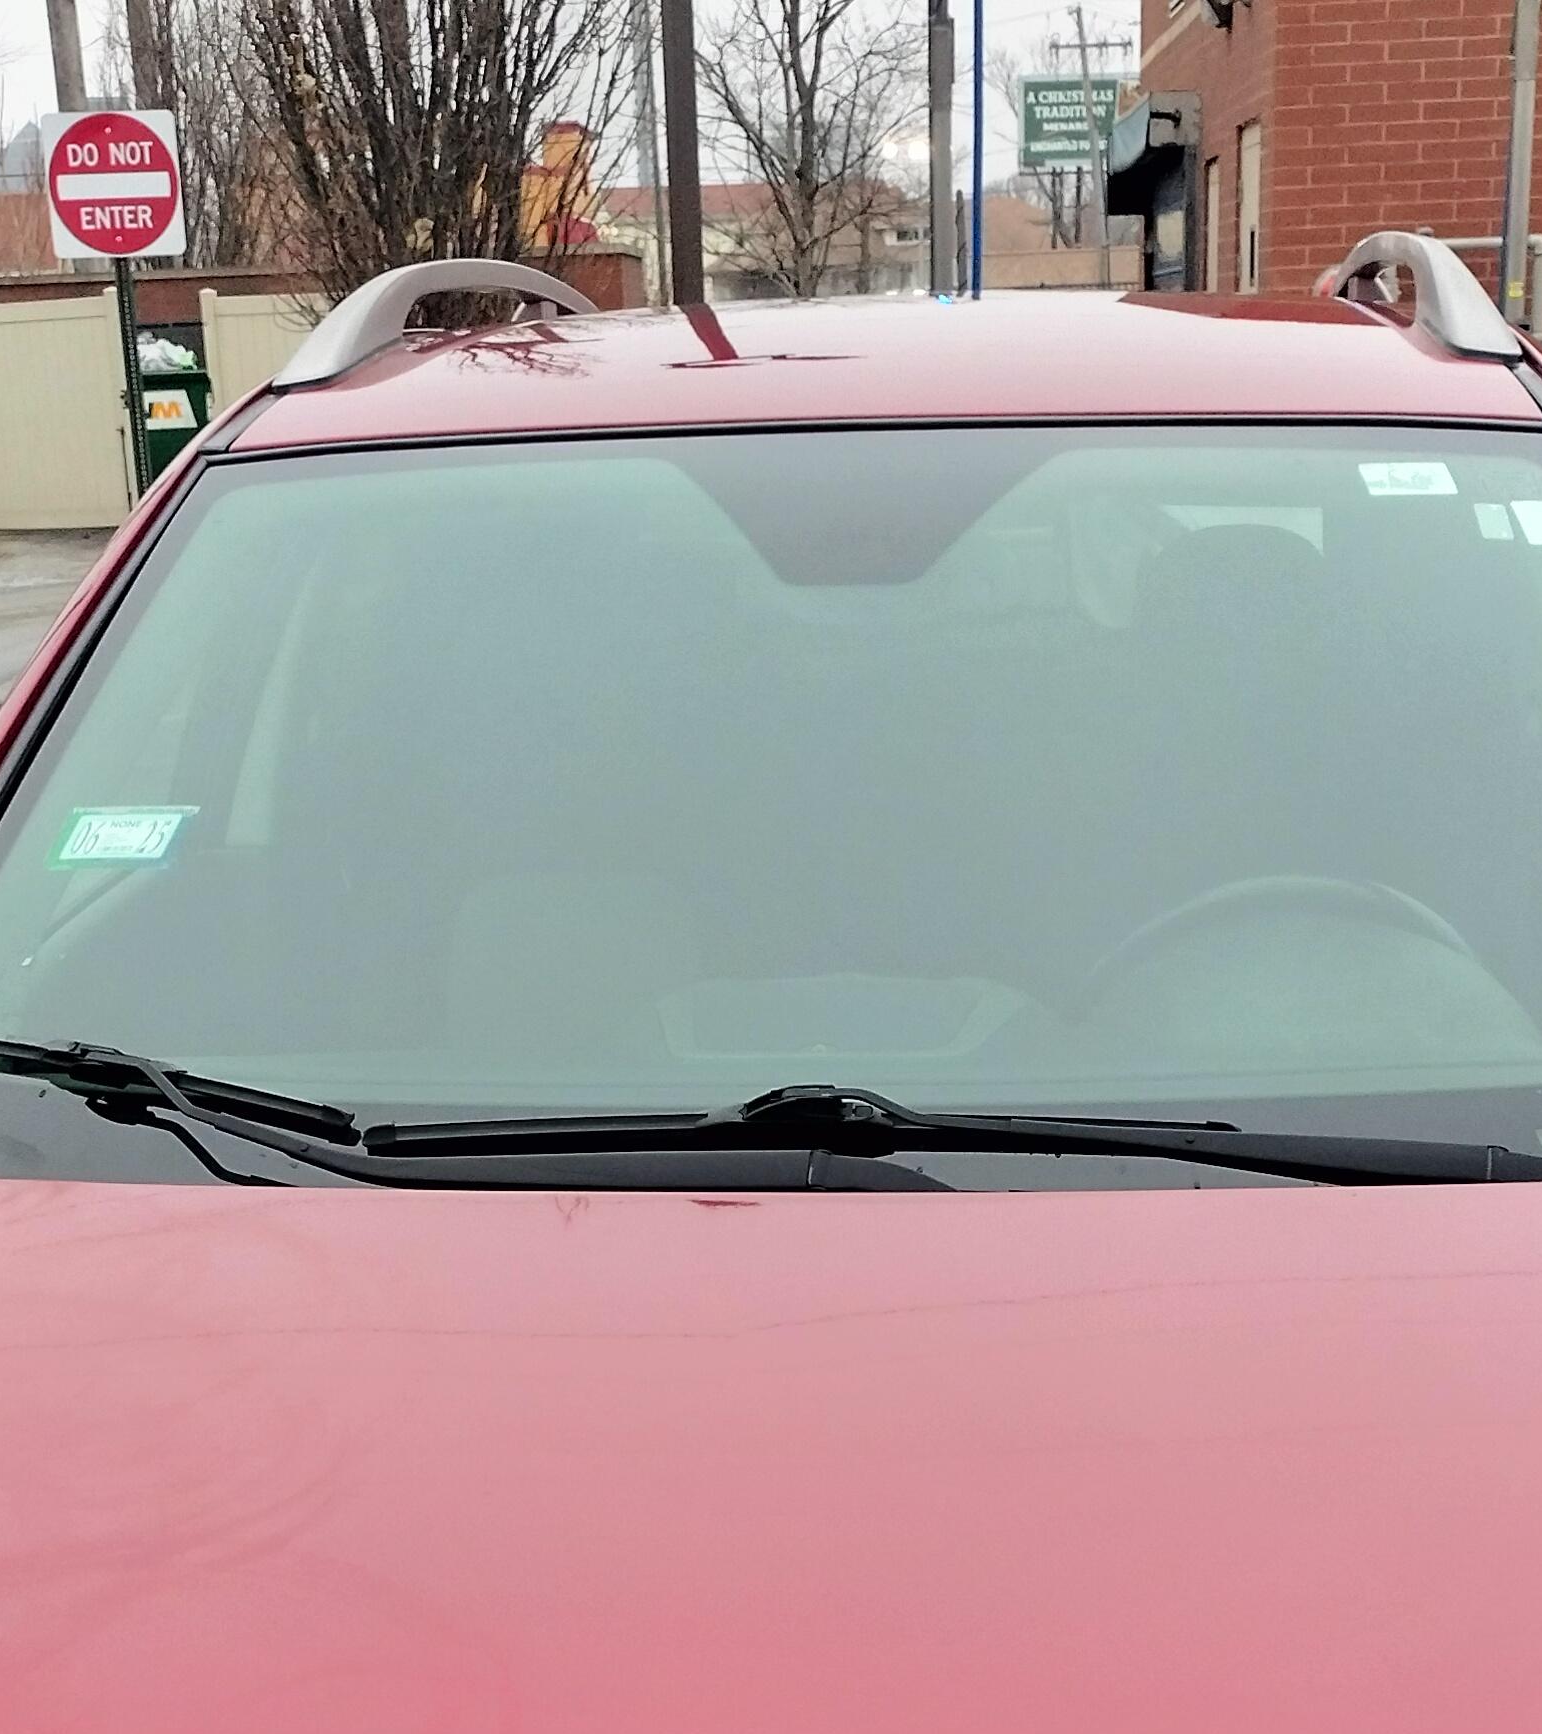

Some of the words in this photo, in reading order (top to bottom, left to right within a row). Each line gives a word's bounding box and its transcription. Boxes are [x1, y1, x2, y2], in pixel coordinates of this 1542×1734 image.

[1026, 91, 1036, 104] A
[66, 143, 99, 167] DO
[109, 141, 154, 166] NOT
[79, 205, 154, 230] ENTER
[70, 820, 107, 855] 06
